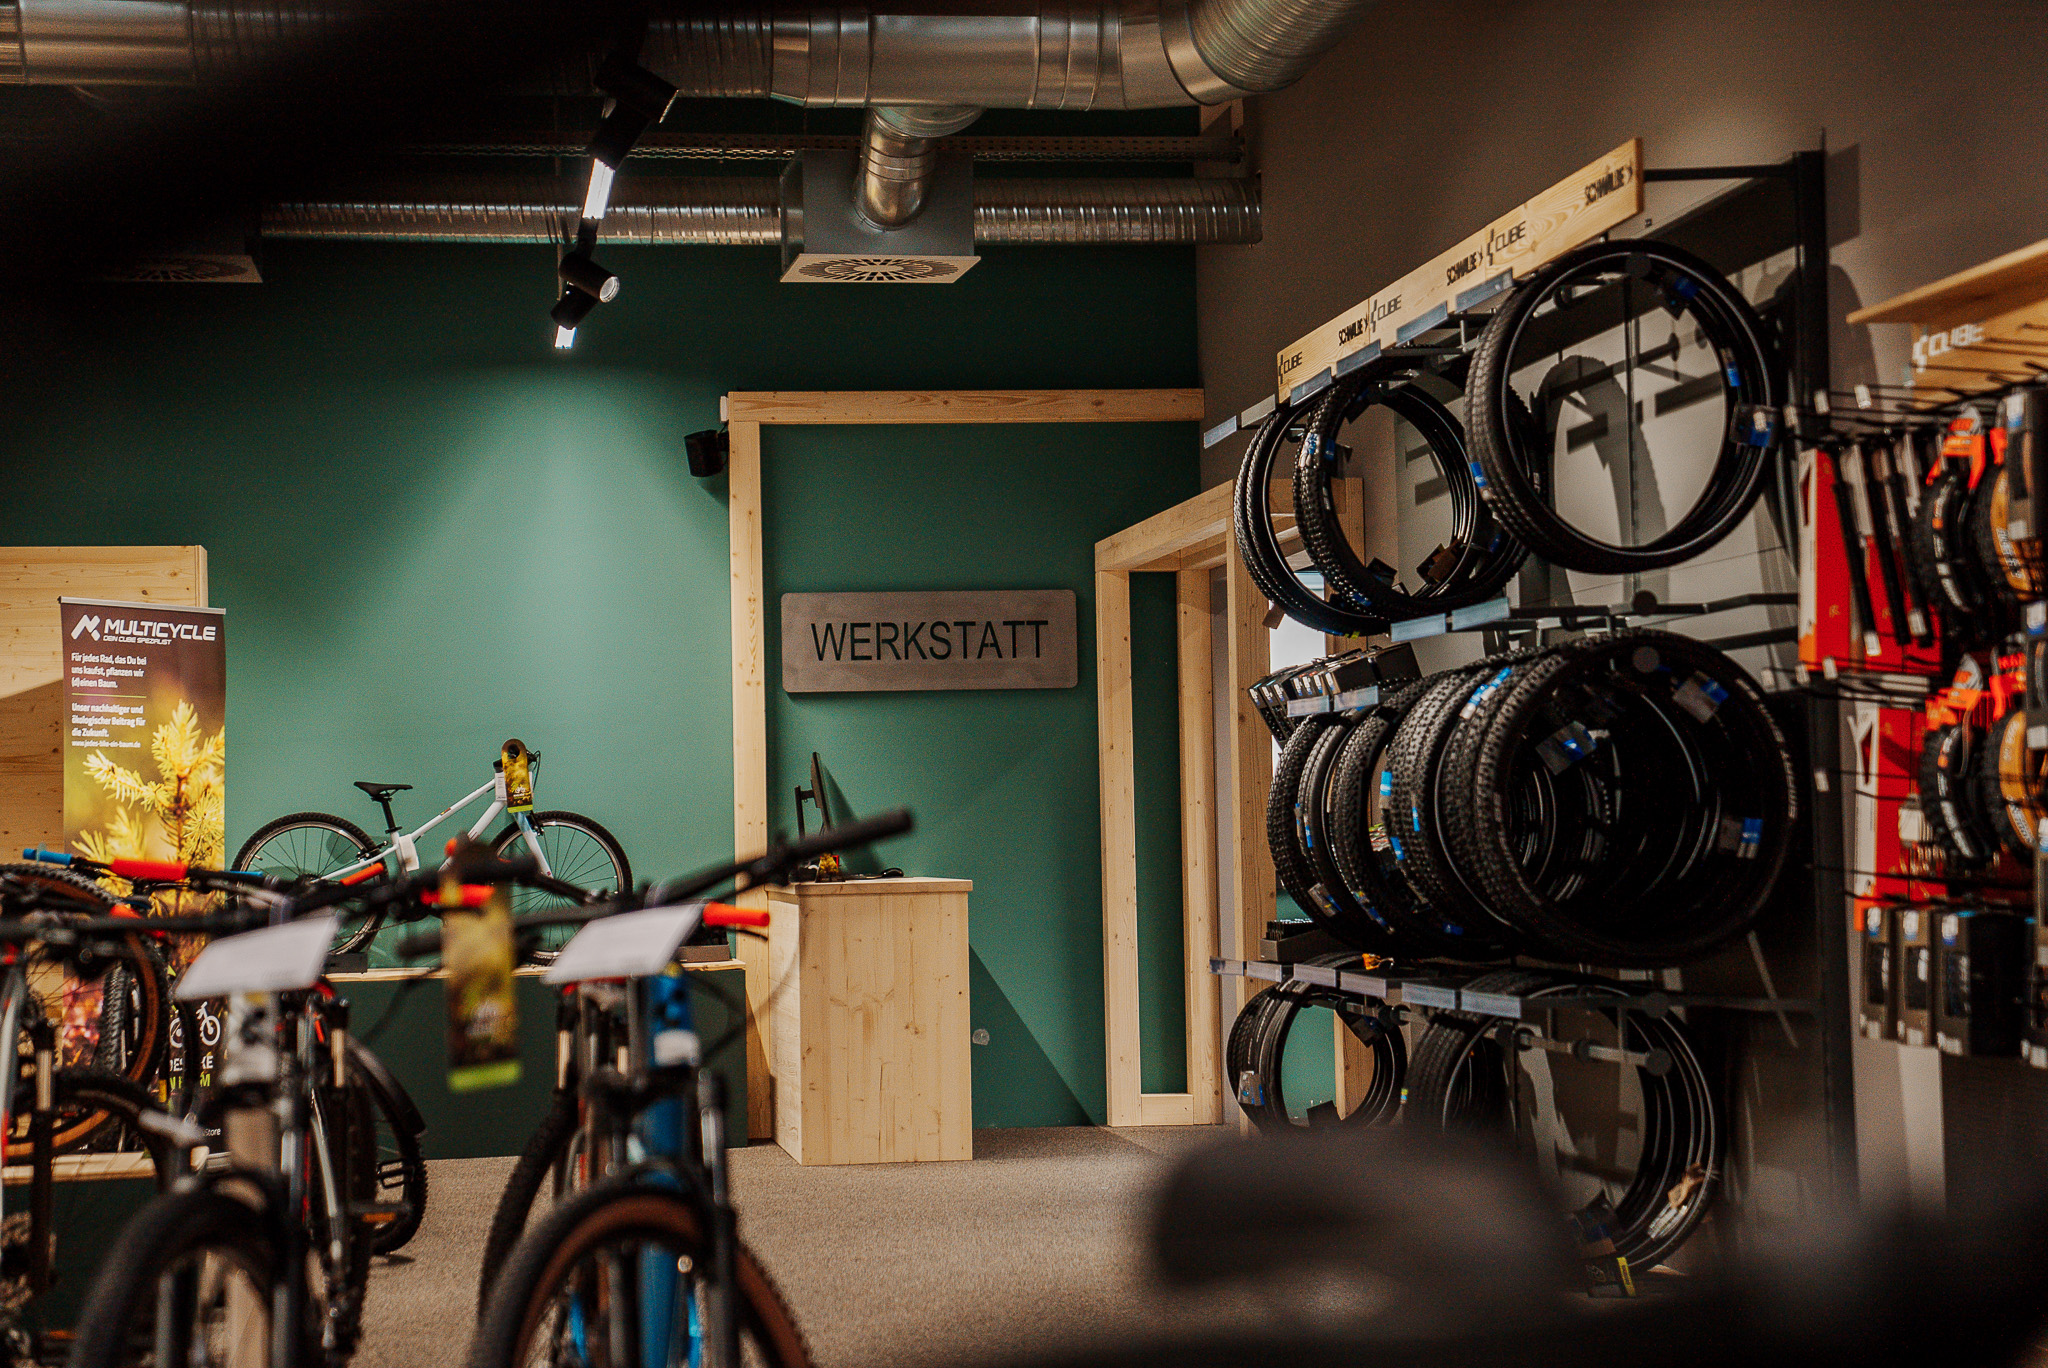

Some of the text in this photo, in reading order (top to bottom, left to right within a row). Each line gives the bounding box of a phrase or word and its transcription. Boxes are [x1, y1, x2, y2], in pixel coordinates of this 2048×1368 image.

[1284, 165, 1625, 374] CUBE SCHWALBE CUBE SCHWALBE CUBE SCHWALBE
[1928, 324, 1985, 357] CUBE
[104, 618, 216, 641] MULTICYCLE
[102, 634, 118, 642] DEIN
[810, 620, 1049, 661] WERKSTATT
[71, 652, 147, 665] Für jedes Rad, das Du bei
[71, 665, 145, 677] uns kaufst, pflanzen wir
[98, 678, 118, 688] Baum.
[71, 702, 144, 715] Unser nachhaltiger und
[71, 714, 146, 728] ökologischer Beitrag für
[71, 727, 109, 737] die Zukunft.
